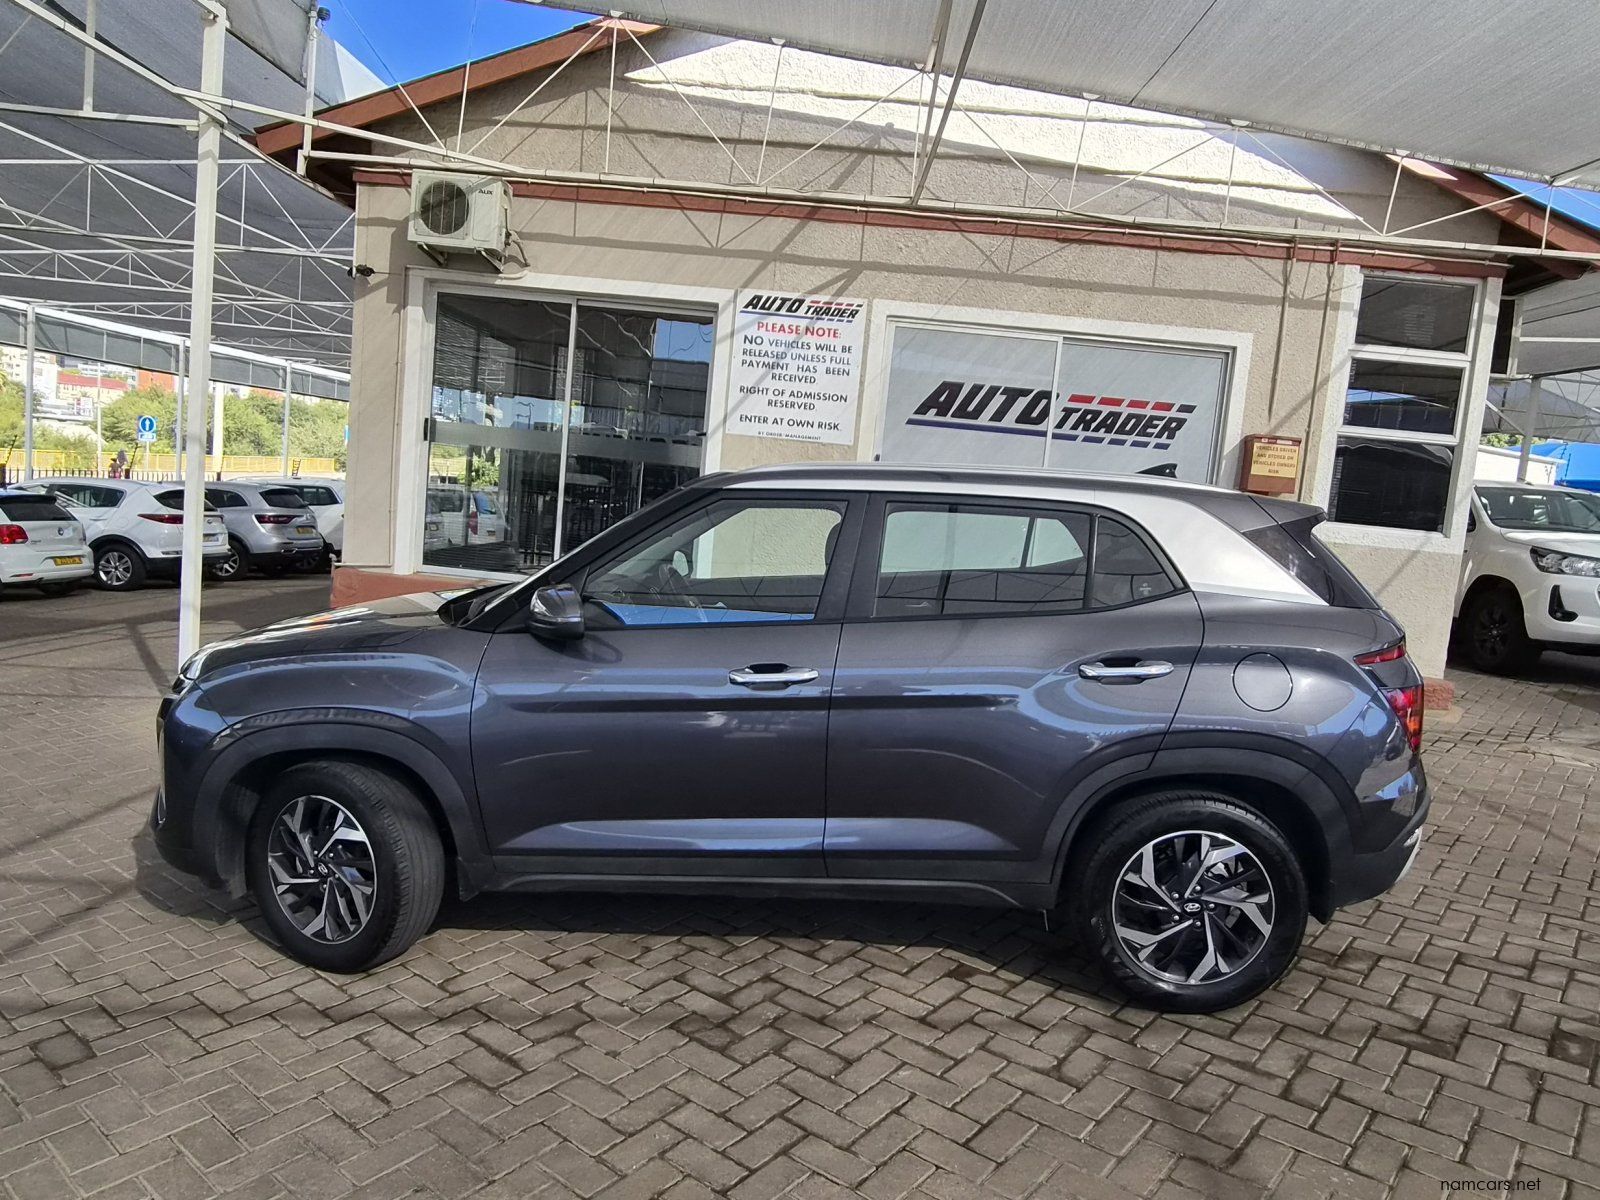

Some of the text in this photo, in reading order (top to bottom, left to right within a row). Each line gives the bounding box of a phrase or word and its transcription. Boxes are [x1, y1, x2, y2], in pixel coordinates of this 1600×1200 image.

[743, 294, 860, 319] AUTO TRADER
[757, 321, 842, 339] PLEASE NOTE:
[743, 334, 853, 354] NO VEHICLES WILL BE
[742, 348, 852, 366] RELEASED UNLESS FULL
[741, 359, 850, 376] PAYMENT HAS BEEN
[739, 385, 848, 403] RIGHT OF ADMISSION
[912, 380, 1188, 440] AUTO TRADER
[739, 414, 769, 425] ENTER
[771, 417, 785, 426] AT
[787, 418, 815, 429] OWN
[785, 433, 822, 441] MANAGEMENT
